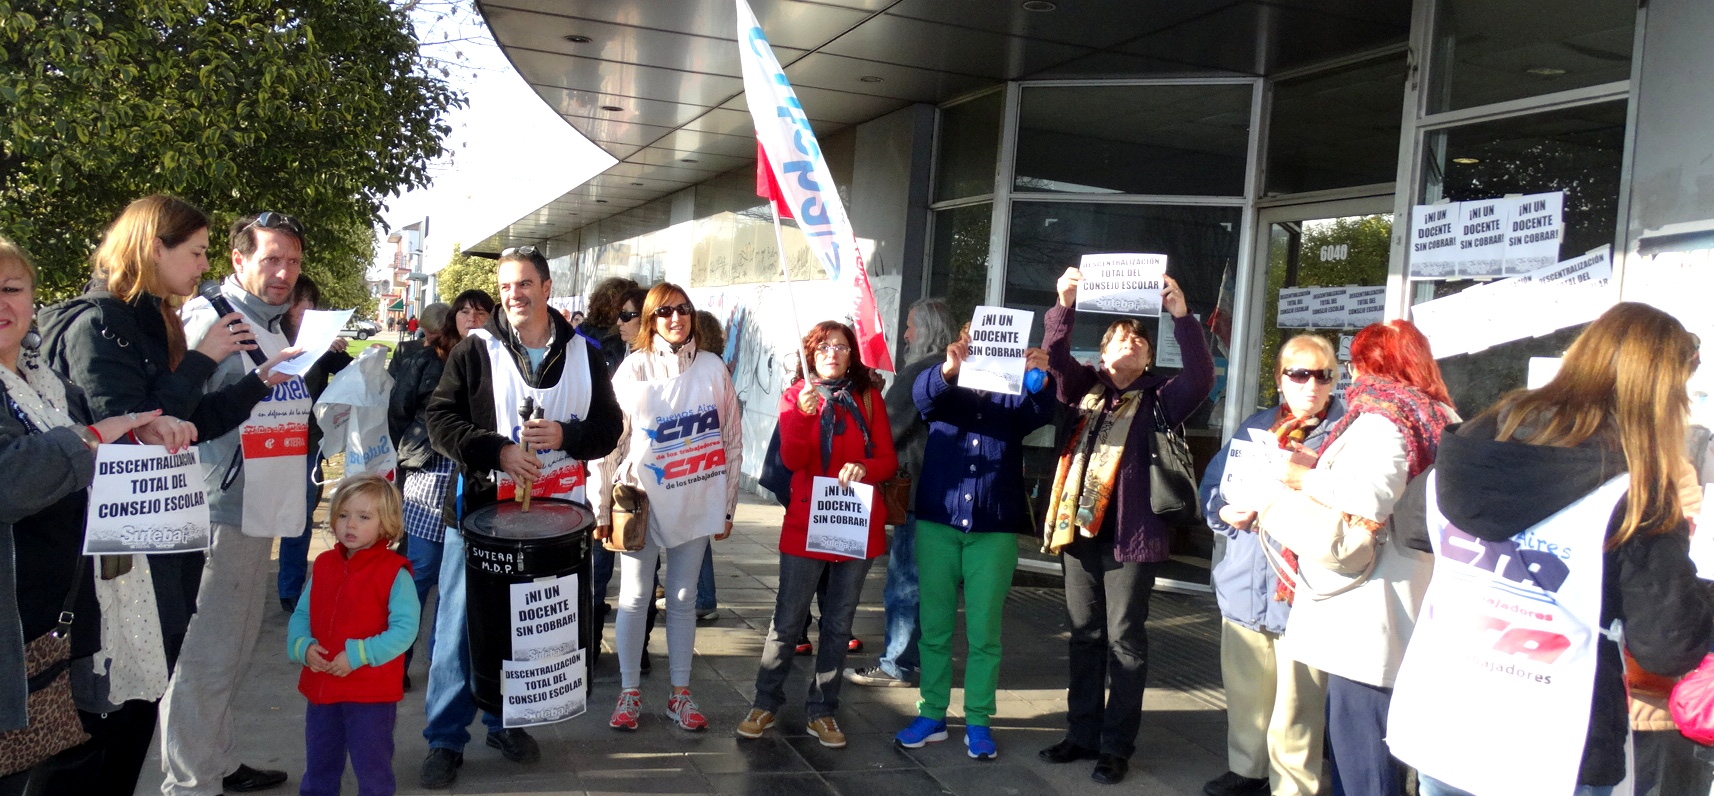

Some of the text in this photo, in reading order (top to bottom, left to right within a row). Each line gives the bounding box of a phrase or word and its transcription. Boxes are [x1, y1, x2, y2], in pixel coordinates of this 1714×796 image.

[1469, 205, 1494, 220] ¡NI UN
[1519, 200, 1546, 216] ¡NI UN
[1425, 209, 1447, 224] ¡NI UN
[1512, 215, 1552, 232] DOCENTE
[1418, 223, 1451, 238] DOCENTE
[1463, 219, 1500, 235] DOCENTE
[1414, 237, 1456, 252] SIN COBRAR!
[1460, 233, 1504, 249] SIN COBRAR!
[1509, 229, 1559, 246] SIN COBRAR!
[1320, 244, 1348, 261] 6040
[1101, 269, 1124, 277] TOTAL
[1083, 281, 1159, 290] CONSEJO ESCOLAR
[981, 314, 1013, 326] ¡NI UN
[973, 330, 1019, 343] DOCENTE
[968, 346, 1025, 357] SIN COBRAR!
[656, 409, 694, 424] Buenos
[656, 408, 720, 443] CTA
[679, 441, 720, 455] trabajadores
[99, 450, 196, 475] DESCENTRALIZACIÓN
[663, 448, 726, 480] CTA
[131, 473, 187, 494] TOTAL DEL
[688, 470, 726, 484] trabajadore
[825, 486, 839, 497] ¡NI
[98, 491, 205, 518] CONSEJO ESCOLAR
[817, 501, 862, 513] DOCENTE
[813, 515, 867, 527] SIN COBRAR!
[1515, 530, 1572, 559] Aires
[1440, 520, 1570, 593] CTA
[525, 585, 560, 605] ¡NI UN
[518, 599, 570, 622] DOCENTE
[516, 612, 577, 637] SIN COBRAR!
[505, 653, 581, 679] DESCENTRALIZACIÓN
[525, 672, 567, 691] TOTAL DEL
[508, 678, 583, 706] CONSEJO ESCOLAR
